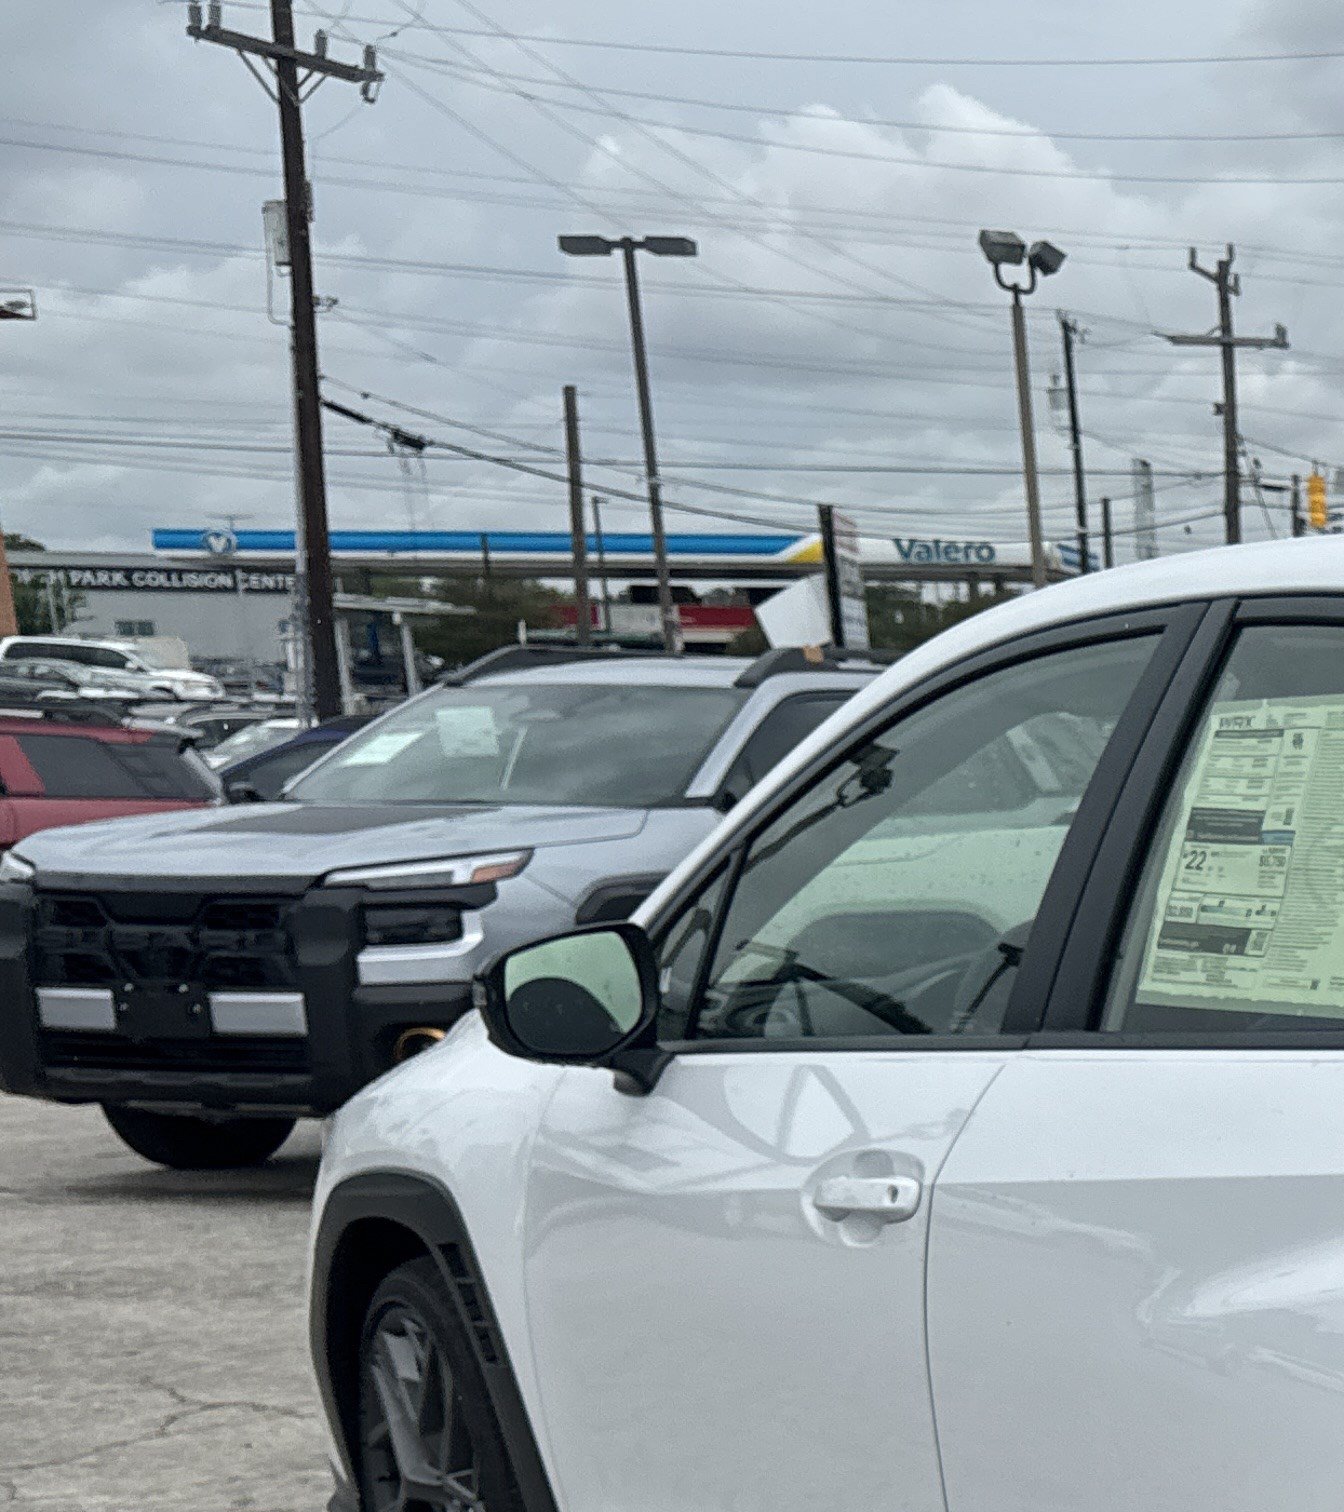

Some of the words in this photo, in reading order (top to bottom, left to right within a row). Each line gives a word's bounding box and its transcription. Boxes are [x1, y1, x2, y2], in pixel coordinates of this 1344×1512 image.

[893, 539, 995, 563] Valero
[69, 569, 126, 587] PARK
[131, 570, 235, 588] COLLISION
